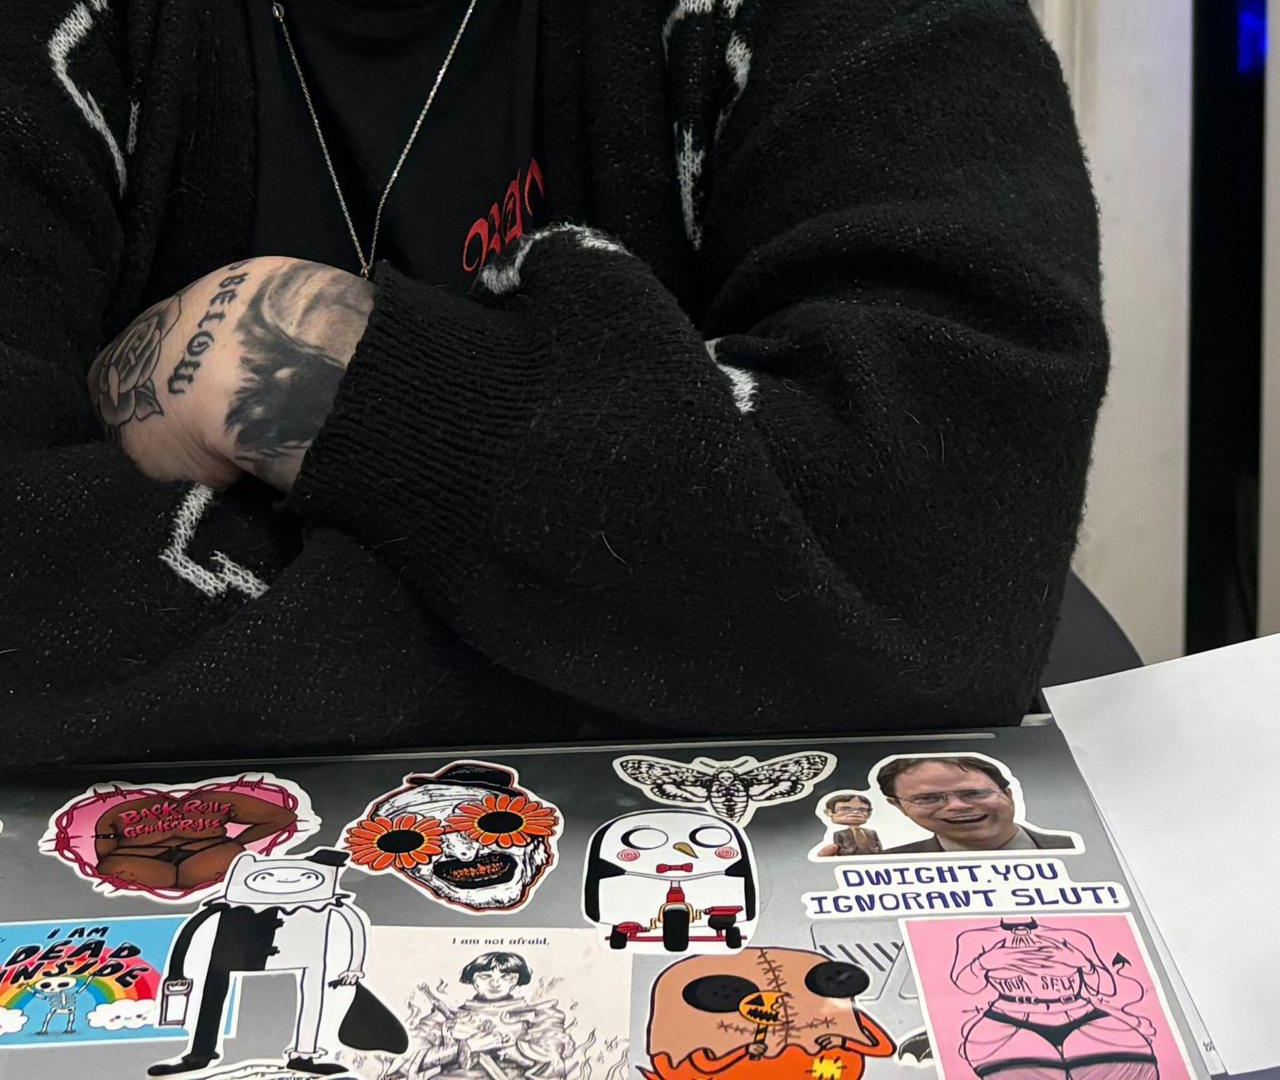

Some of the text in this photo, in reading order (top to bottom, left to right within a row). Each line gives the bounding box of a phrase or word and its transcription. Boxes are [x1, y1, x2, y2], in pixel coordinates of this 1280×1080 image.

[810, 886, 1119, 914] IGNORANT SLUT!
[47, 926, 110, 939] I AM
[484, 937, 504, 945] not
[4, 938, 142, 968] DEAD
